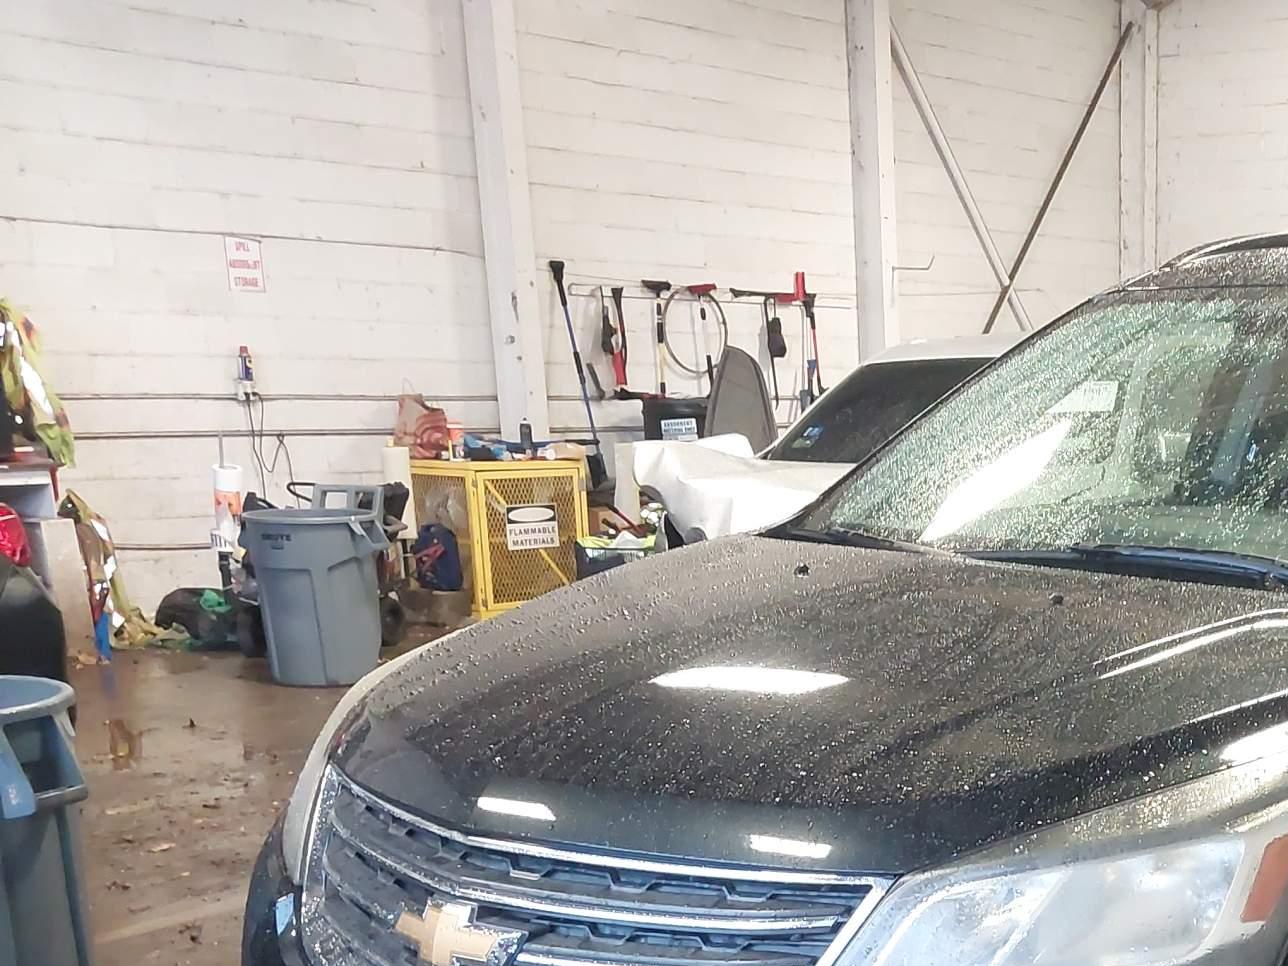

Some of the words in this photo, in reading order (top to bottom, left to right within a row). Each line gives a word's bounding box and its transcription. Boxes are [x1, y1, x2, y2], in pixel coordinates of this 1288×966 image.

[233, 276, 259, 287] STORAGE
[509, 526, 556, 537] FLAMMABLE
[512, 537, 555, 547] MATERIALS
